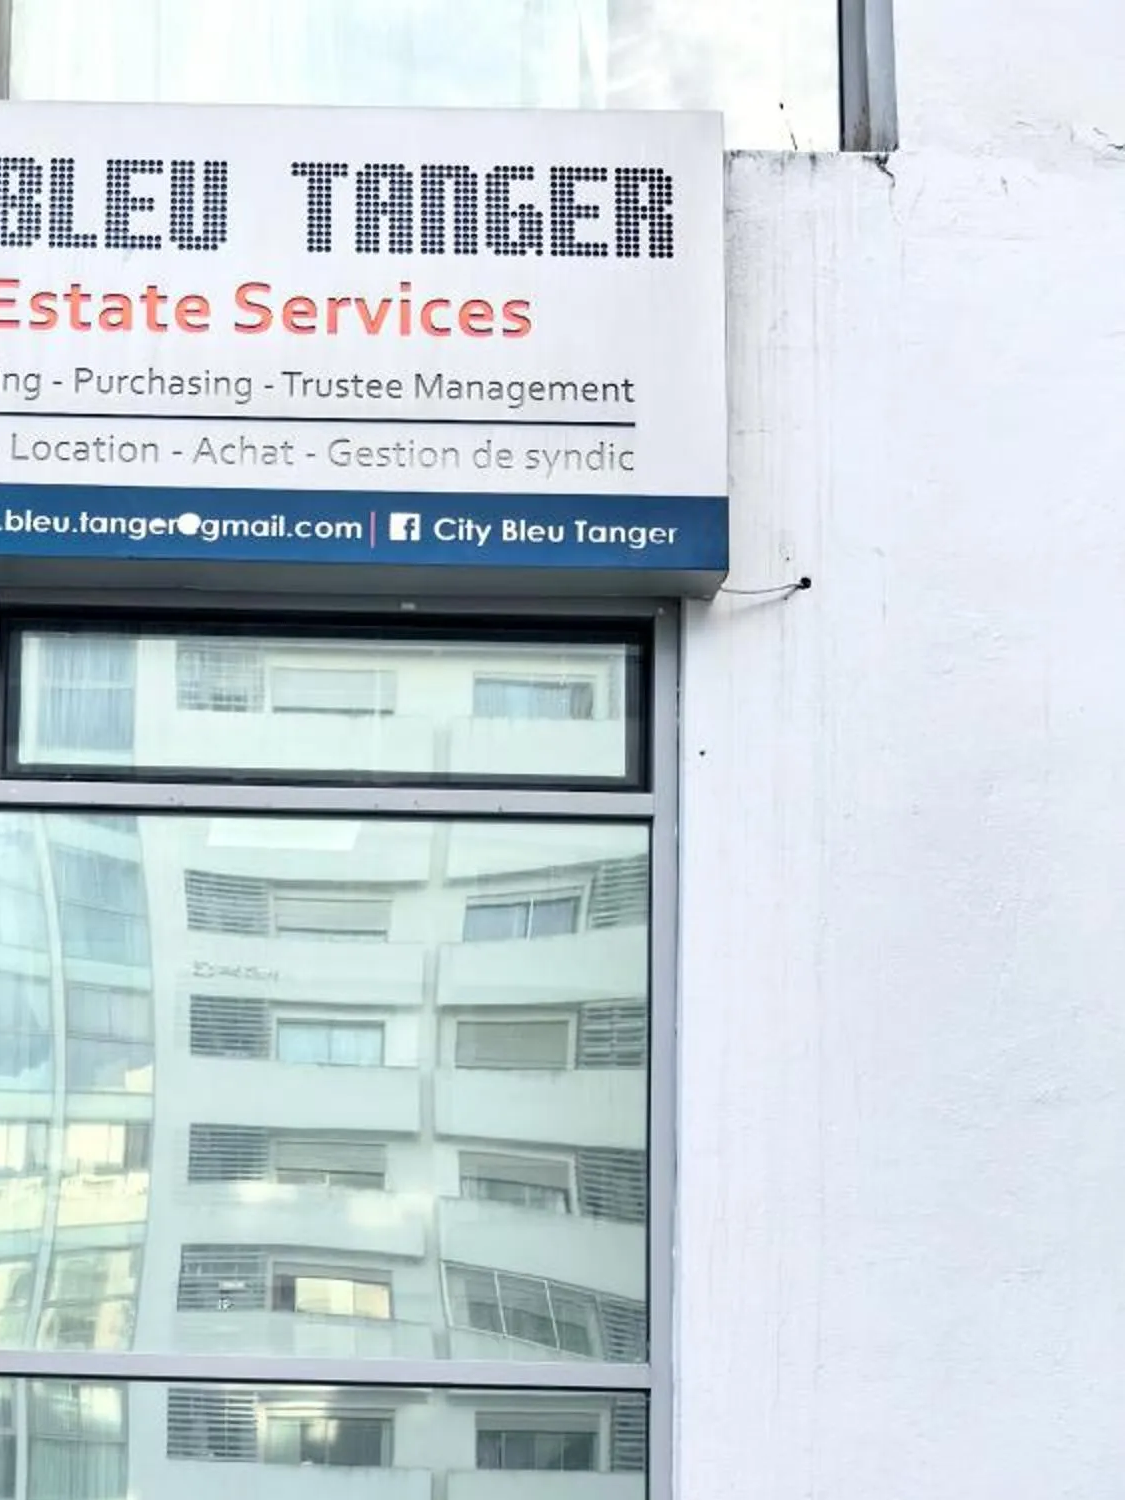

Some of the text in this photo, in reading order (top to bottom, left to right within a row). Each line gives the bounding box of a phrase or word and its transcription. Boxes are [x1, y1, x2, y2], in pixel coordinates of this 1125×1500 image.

[290, 160, 675, 260] TANGER
[233, 280, 534, 339] Services
[74, 366, 252, 406] Purchasing
[280, 370, 404, 400] Trustee
[414, 372, 636, 409] Management
[10, 432, 160, 464] Location
[192, 434, 295, 466] Achat
[327, 437, 460, 469] Gestion
[472, 438, 514, 470] de
[524, 440, 635, 479] syndic
[433, 517, 678, 549] City Bleu Tanger
